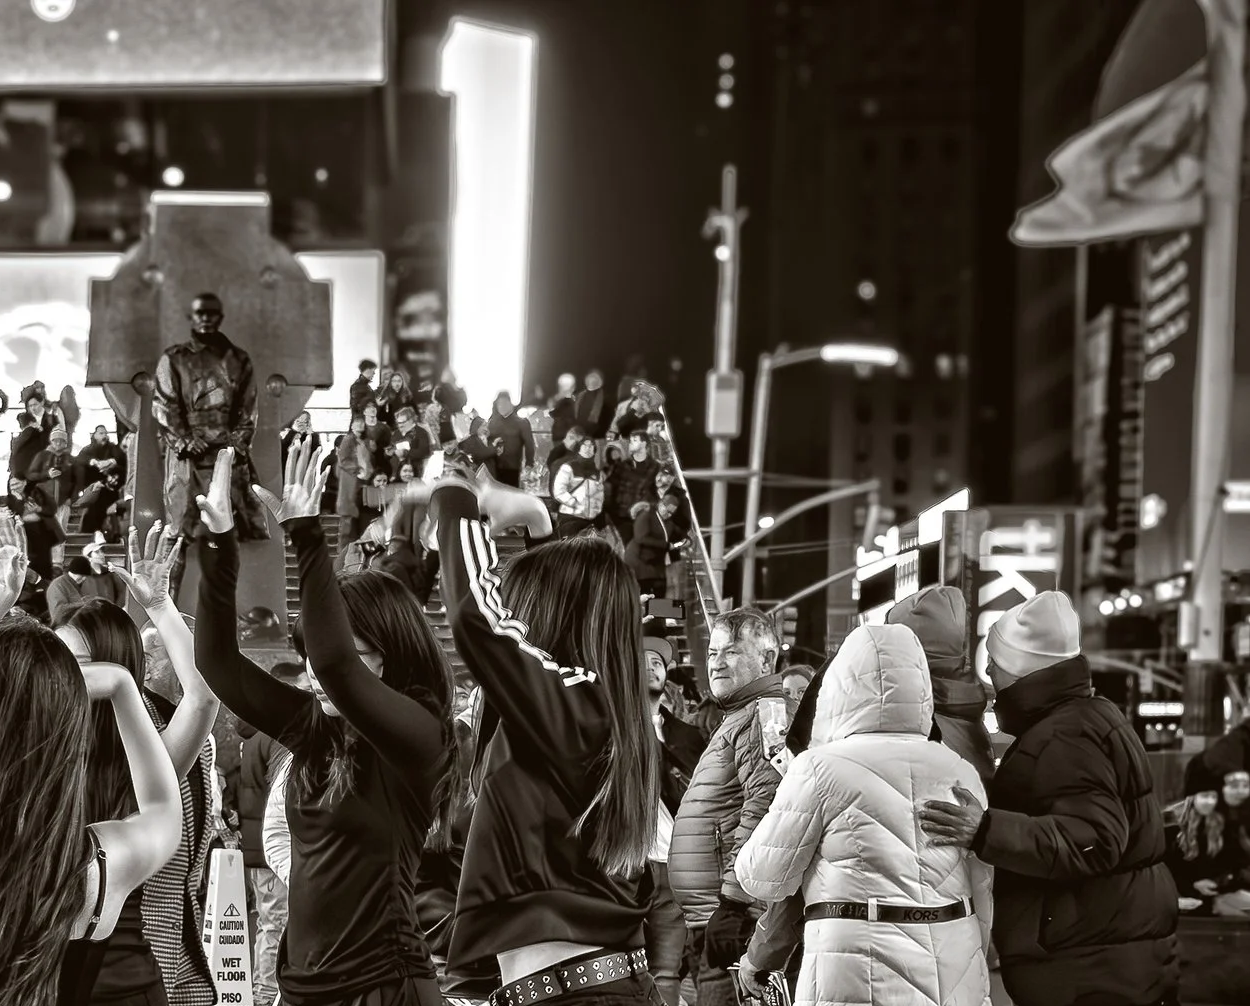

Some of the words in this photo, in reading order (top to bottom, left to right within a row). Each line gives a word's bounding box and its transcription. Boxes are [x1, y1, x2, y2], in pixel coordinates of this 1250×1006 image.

[903, 909, 940, 922] KORS
[219, 920, 244, 931] CAUTION
[218, 934, 245, 945] CUIDADO
[221, 957, 242, 968] WET
[217, 971, 246, 982] FLOOR
[221, 992, 242, 1003] PISO
